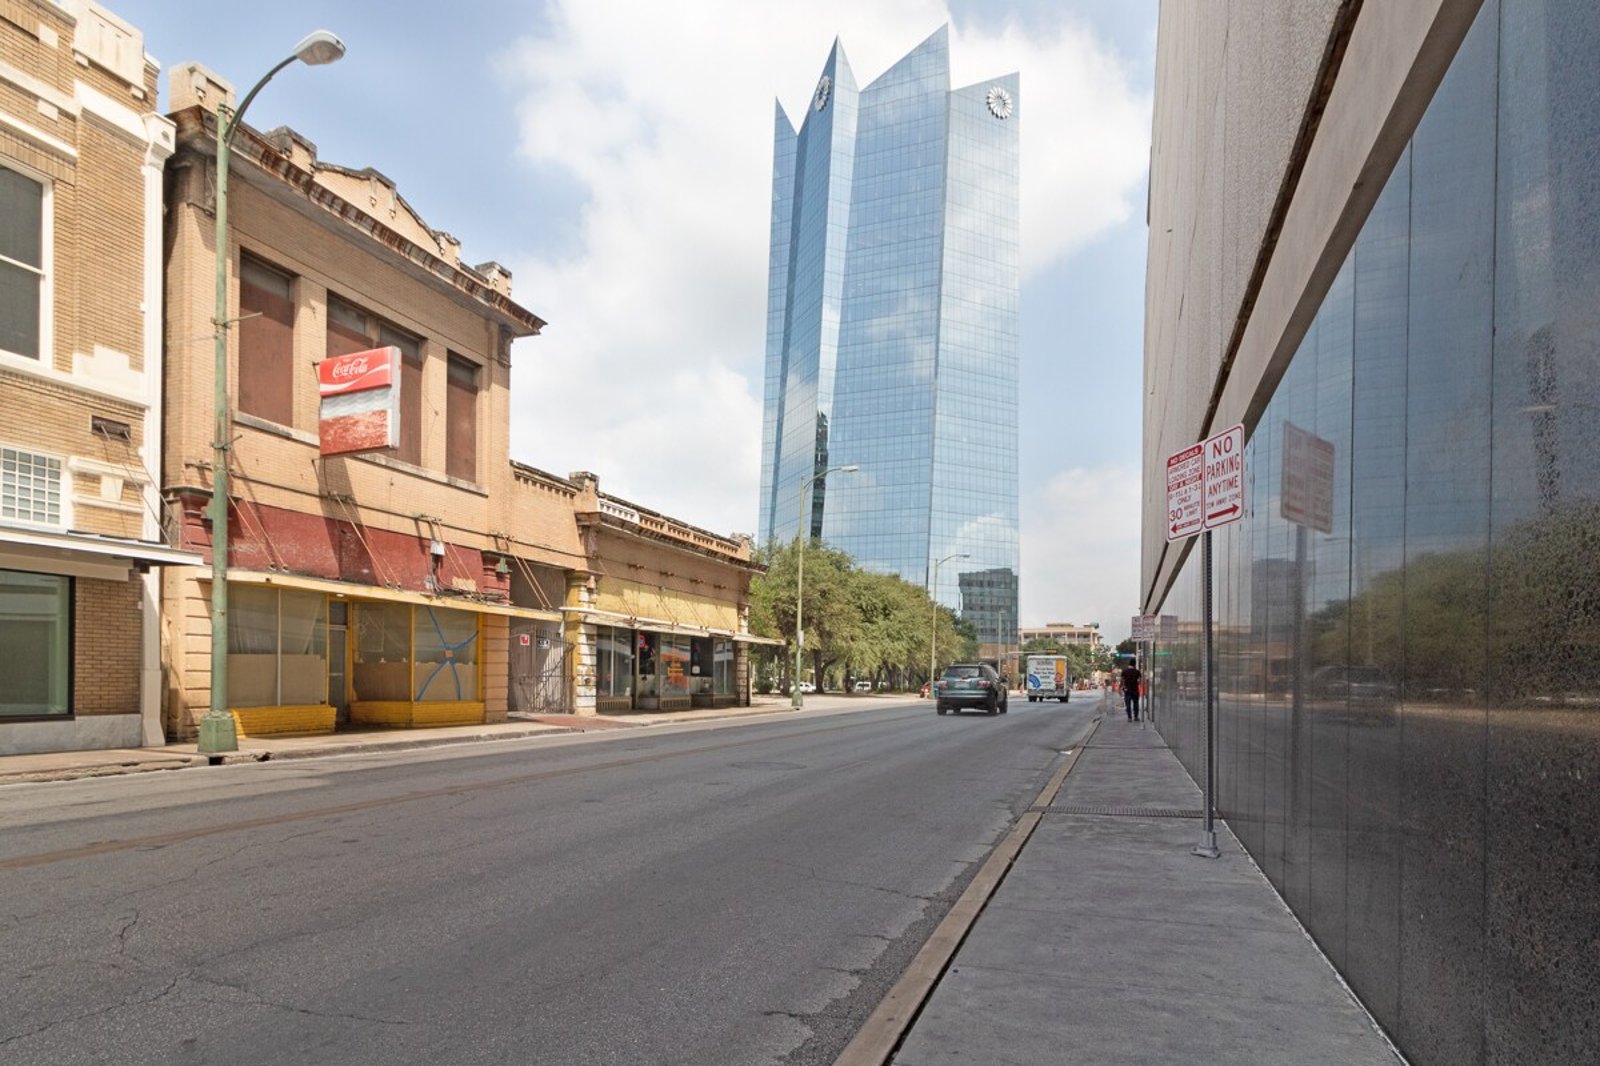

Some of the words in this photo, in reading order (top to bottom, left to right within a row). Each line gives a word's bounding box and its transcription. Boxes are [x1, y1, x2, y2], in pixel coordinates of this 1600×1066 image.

[333, 357, 368, 379] Coca-Cola
[1213, 436, 1233, 459] NO
[1207, 453, 1240, 481] PARKING
[1208, 475, 1239, 497] ANYTIME
[1170, 507, 1183, 522] 30
